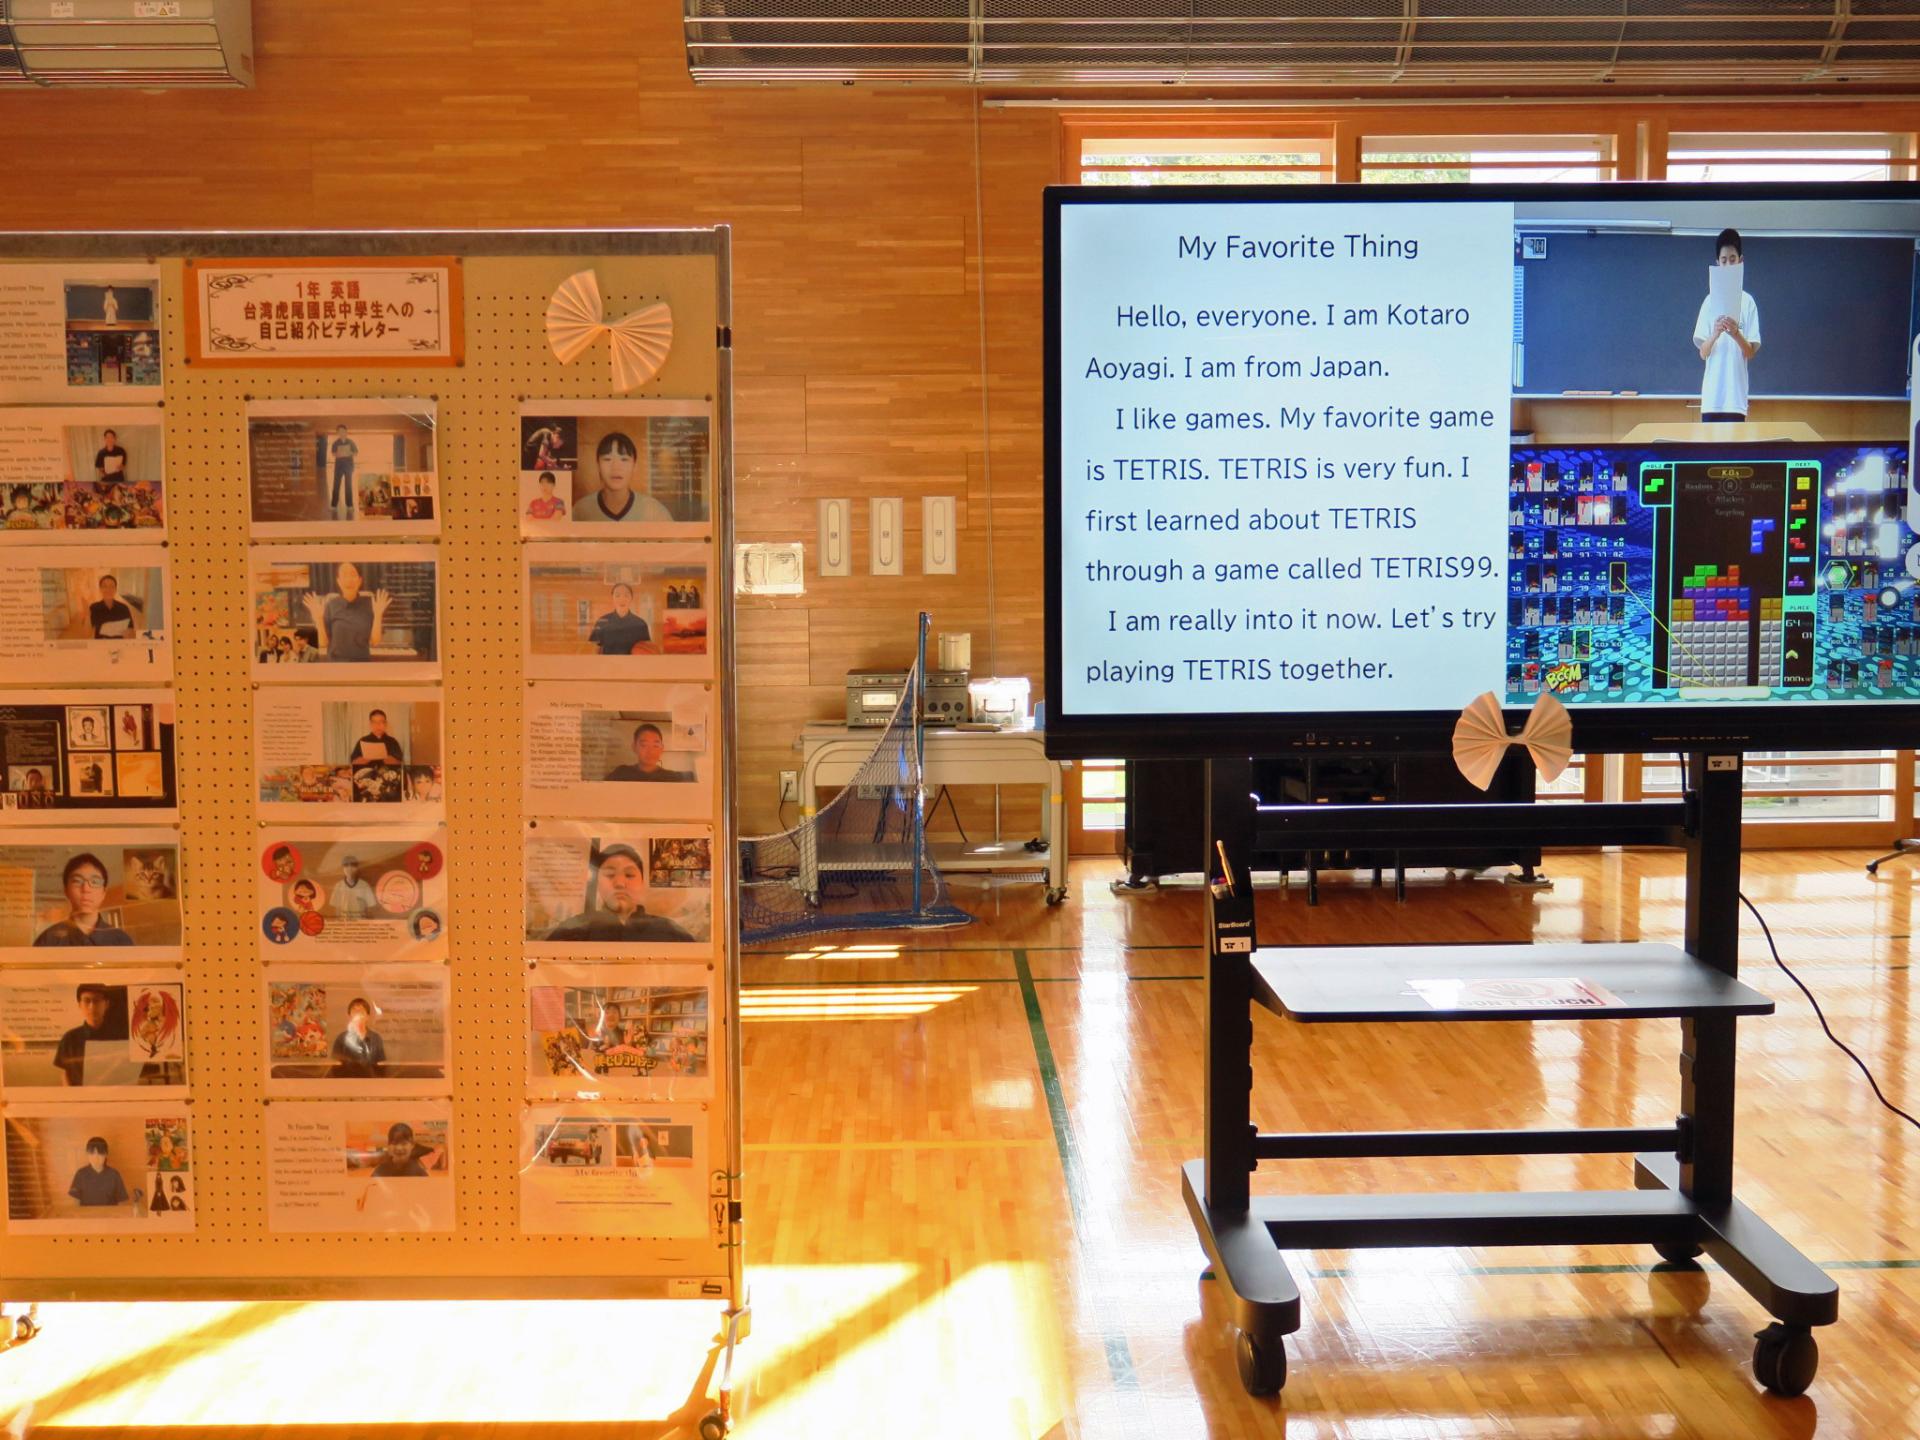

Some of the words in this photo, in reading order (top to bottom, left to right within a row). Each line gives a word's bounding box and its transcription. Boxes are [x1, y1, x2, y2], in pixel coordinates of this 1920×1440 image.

[1178, 235, 1217, 261] My
[1226, 234, 1335, 259] Favorite
[1343, 232, 1418, 260] Thing
[296, 280, 320, 300] 1年
[331, 280, 360, 300] 英語
[1117, 303, 1187, 329] Hello,
[1196, 309, 1317, 329] everyone.
[1327, 303, 1335, 326] I
[1343, 308, 1378, 326] am
[1387, 303, 1470, 326] Kotaro
[259, 320, 400, 341] 自己紹介ビデオレター
[1084, 356, 1175, 381] Aoyagi.
[1184, 356, 1193, 379] I
[1201, 361, 1236, 379] am
[1244, 354, 1301, 378] from
[1309, 355, 1389, 379] Japan.
[1116, 408, 1124, 430] I
[1133, 407, 1177, 430] like
[1185, 412, 1271, 432] games.
[1280, 407, 1316, 431] My
[1322, 405, 1420, 429] favorite
[1429, 410, 1494, 430] game
[1086, 458, 1105, 482] is
[1112, 458, 1209, 481] TETRIS.
[1218, 457, 1308, 480] TETRIS
[1317, 457, 1335, 479] is
[1343, 462, 1396, 481] very
[1403, 455, 1452, 478] fun.
[1461, 456, 1470, 478] I
[1085, 509, 1138, 532] first
[1147, 508, 1239, 532] learned
[1248, 507, 1320, 531] about
[1328, 506, 1417, 530] TETRIS
[1085, 558, 1183, 583] through
[1192, 564, 1205, 581] a
[1214, 563, 1279, 583] game
[1288, 556, 1362, 580] called
[1370, 555, 1499, 579] TETRIS99.
[1108, 610, 1117, 632] I
[1125, 615, 1160, 632] am
[1169, 608, 1237, 633] really
[1245, 608, 1293, 631] into
[1302, 607, 1318, 630] it
[1326, 613, 1382, 630] now.
[1392, 605, 1454, 629] Let's
[1461, 608, 1497, 630] try
[1086, 659, 1174, 684] playing
[1182, 658, 1272, 681] TETRIS
[1279, 656, 1393, 682] together.
